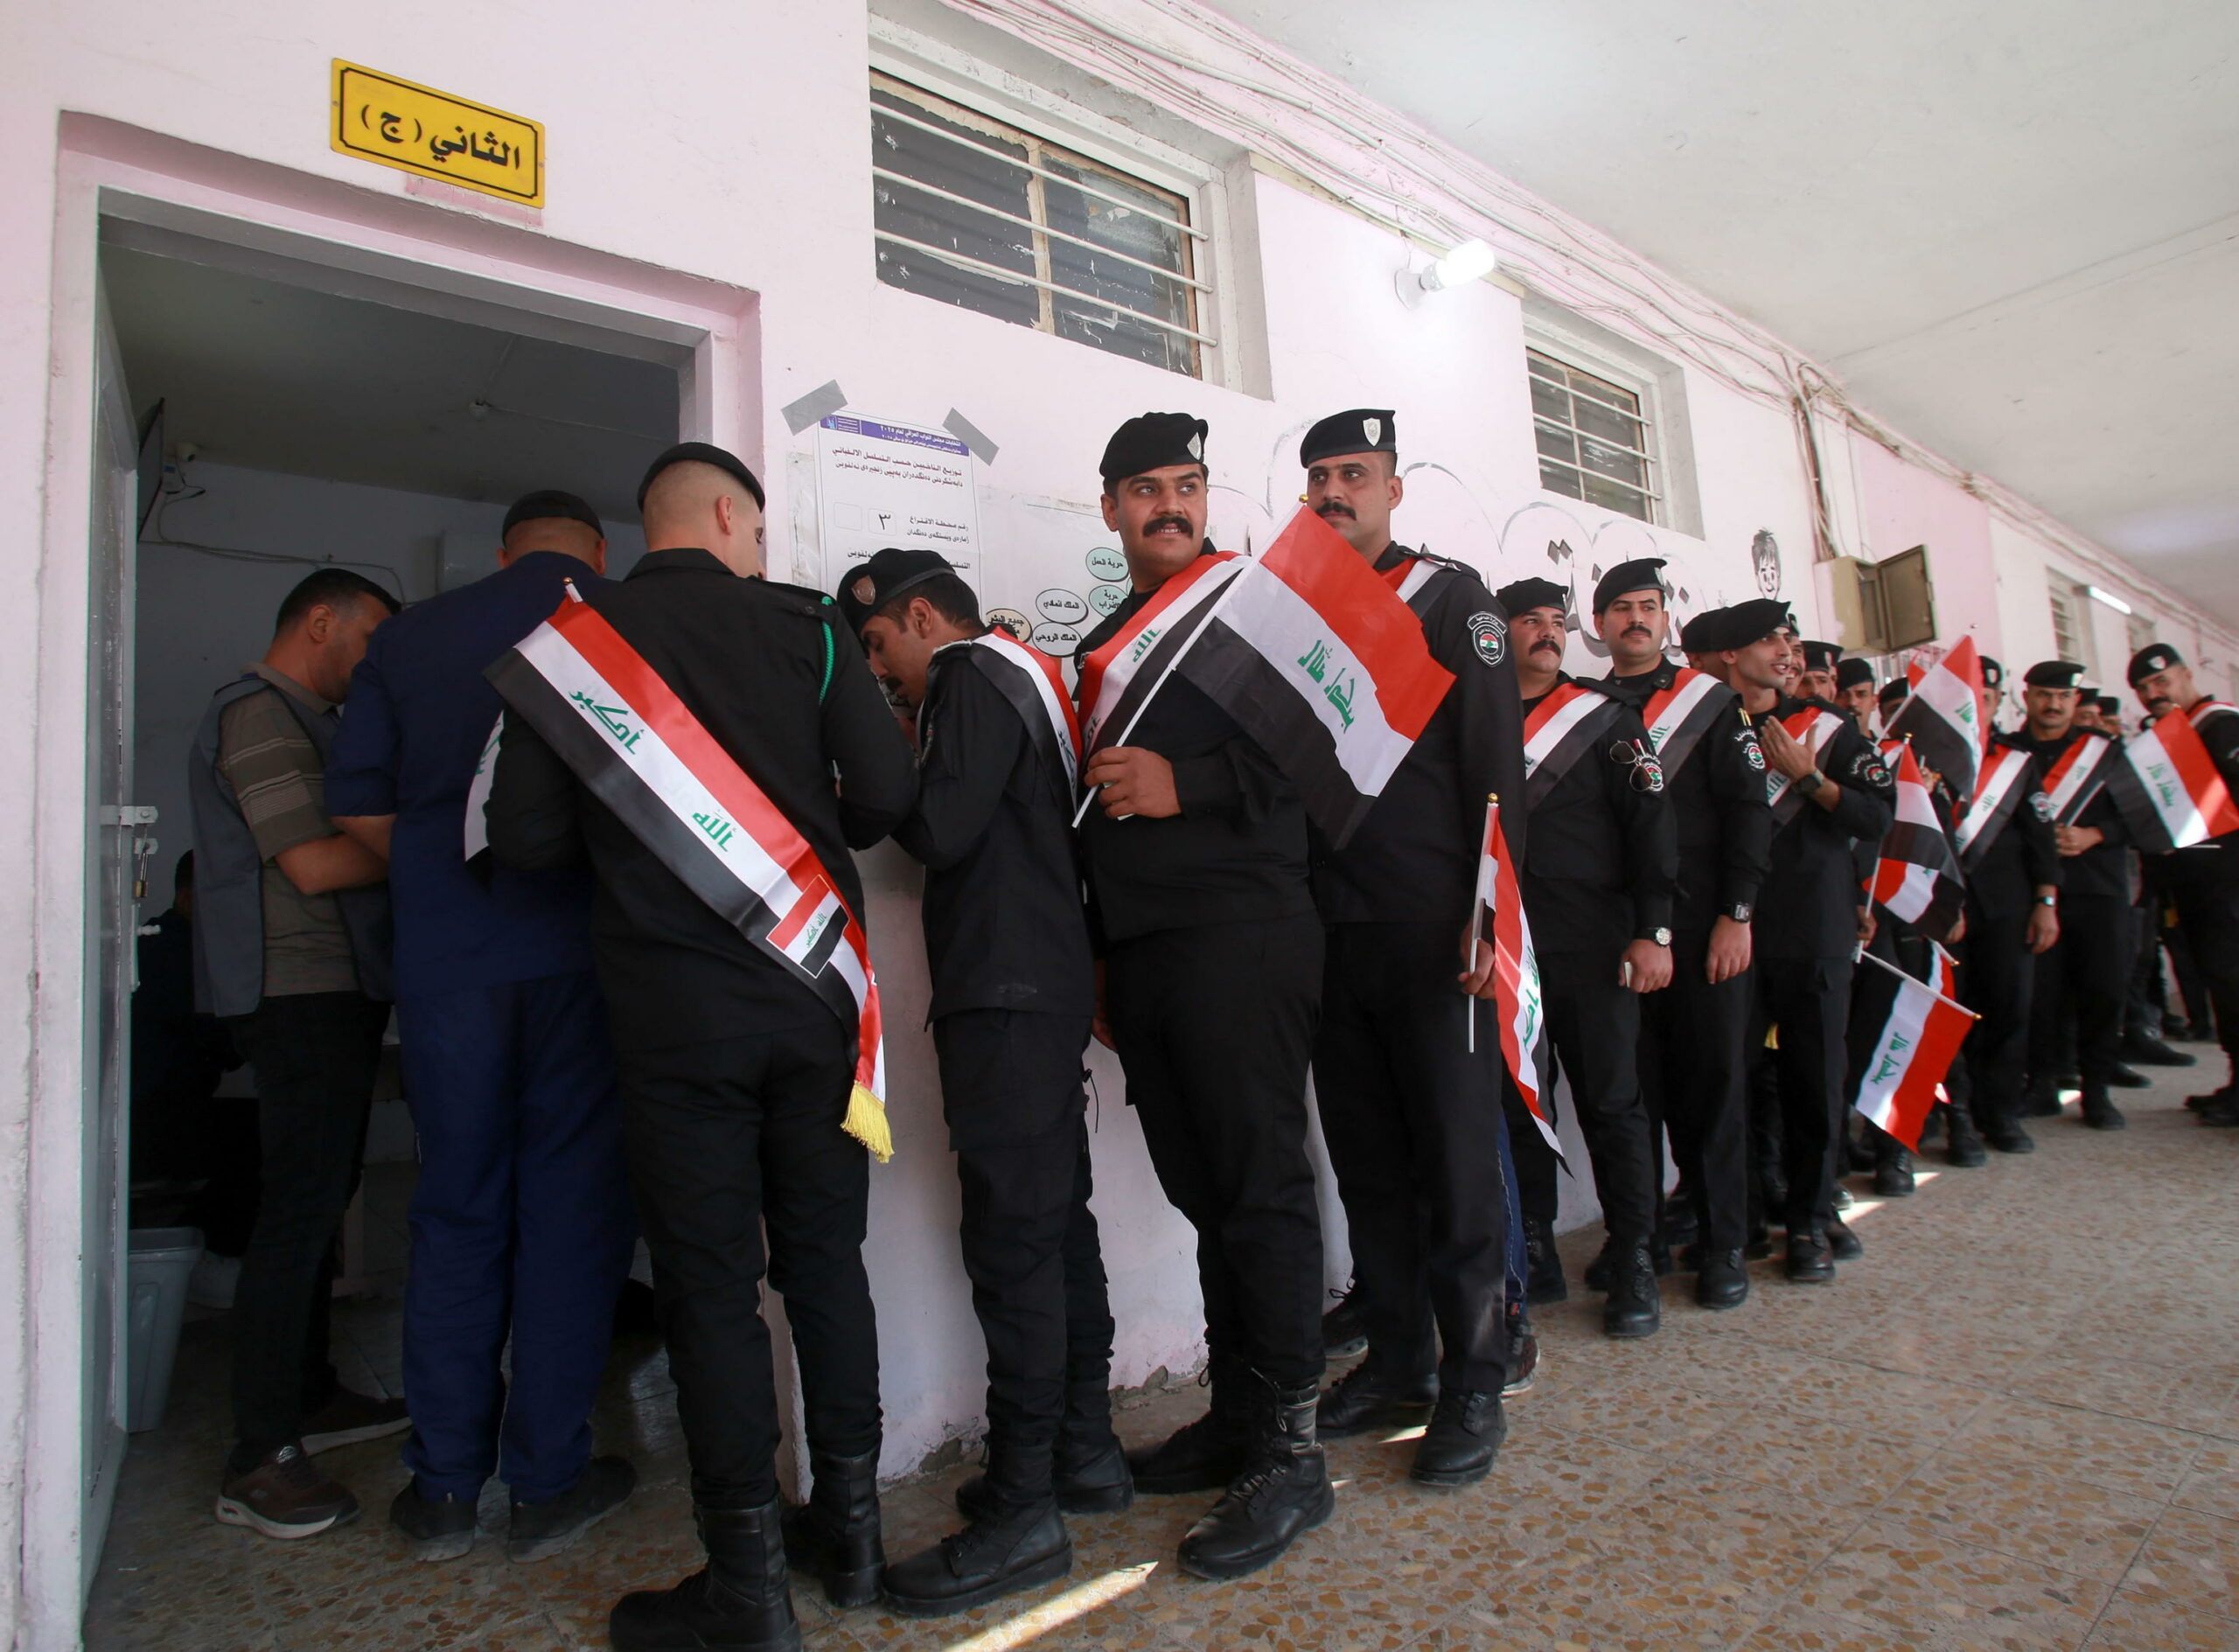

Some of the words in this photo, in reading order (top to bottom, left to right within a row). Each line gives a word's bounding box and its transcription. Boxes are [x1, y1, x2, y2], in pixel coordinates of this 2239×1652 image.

[429, 125, 520, 170] الثاني
[878, 513, 891, 531] ٣
[1107, 558, 1124, 568] حرية
[1104, 589, 1119, 601] حرية
[1133, 629, 1161, 663] الله
[692, 809, 736, 853] الله
